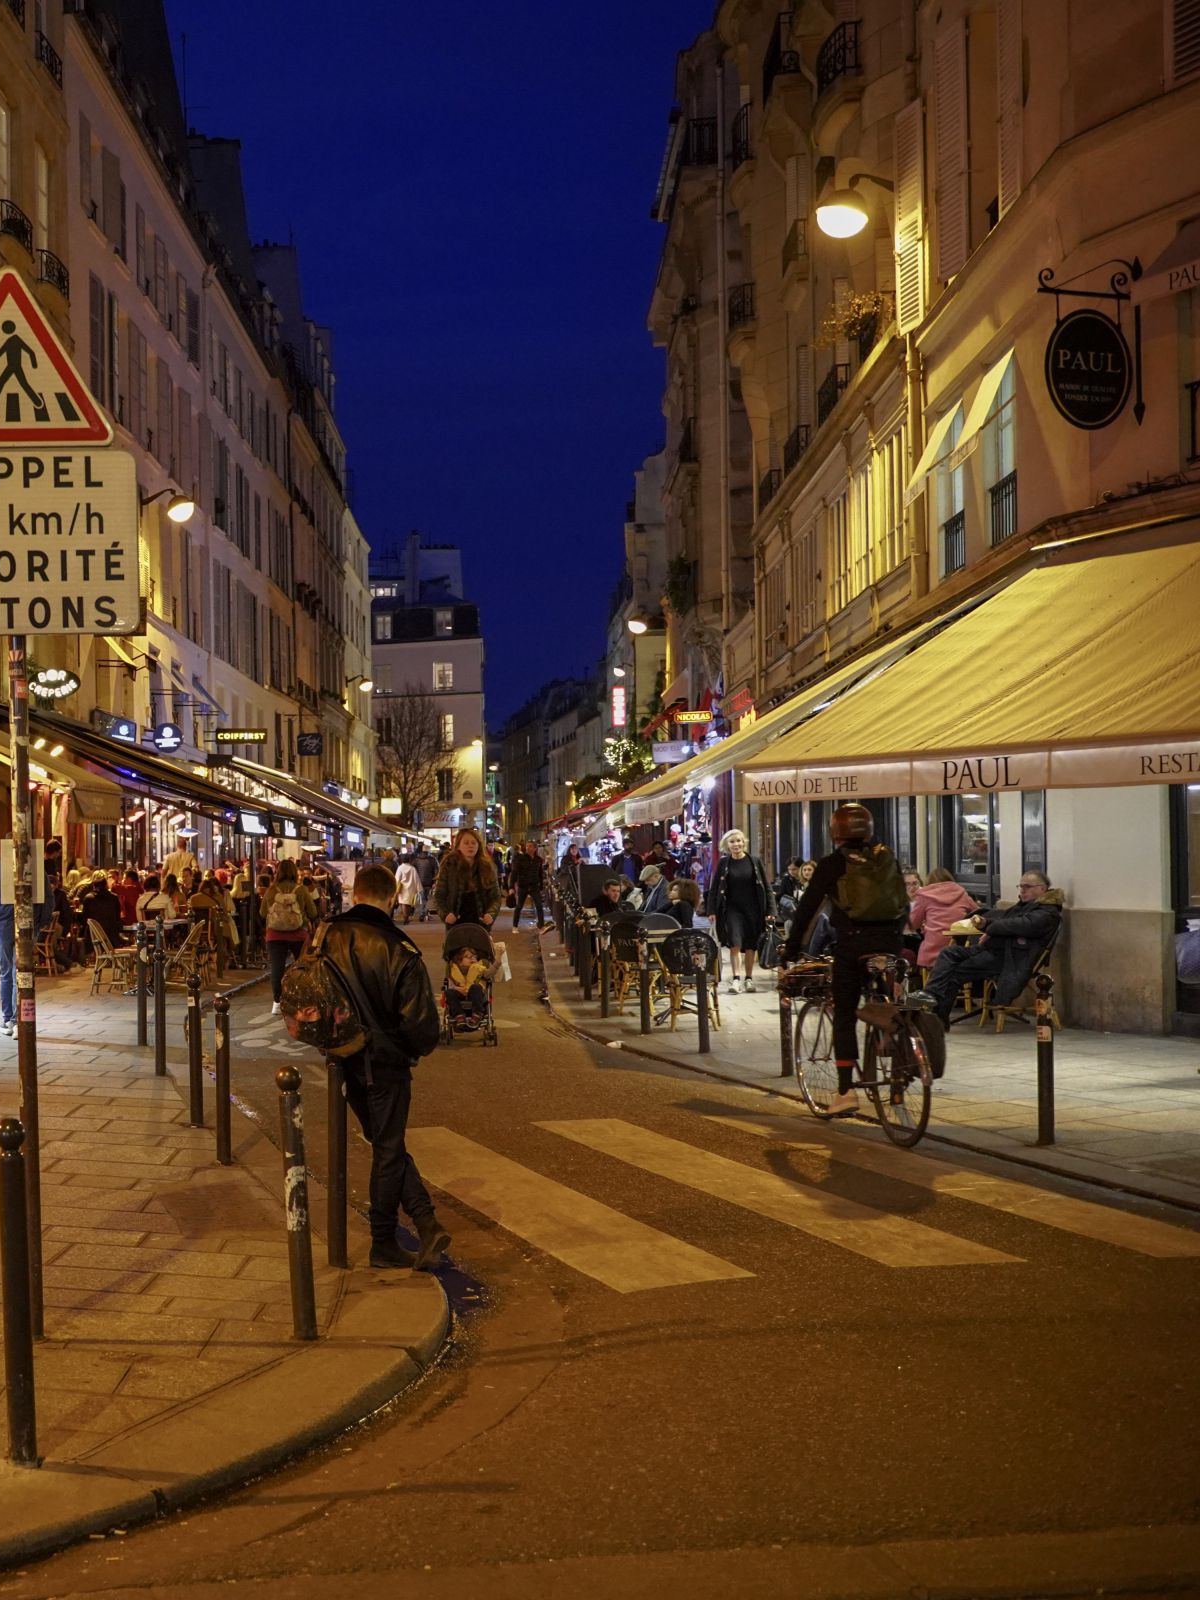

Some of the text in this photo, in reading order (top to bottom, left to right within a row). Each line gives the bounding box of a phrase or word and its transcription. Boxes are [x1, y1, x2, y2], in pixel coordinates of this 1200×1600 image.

[1056, 349, 1122, 373] PAUL
[8, 502, 105, 536] km/h
[676, 712, 711, 721] NICOLAS
[941, 756, 1021, 790] PAUL
[1140, 752, 1200, 776] REST
[753, 775, 858, 797] SALON DE THE
